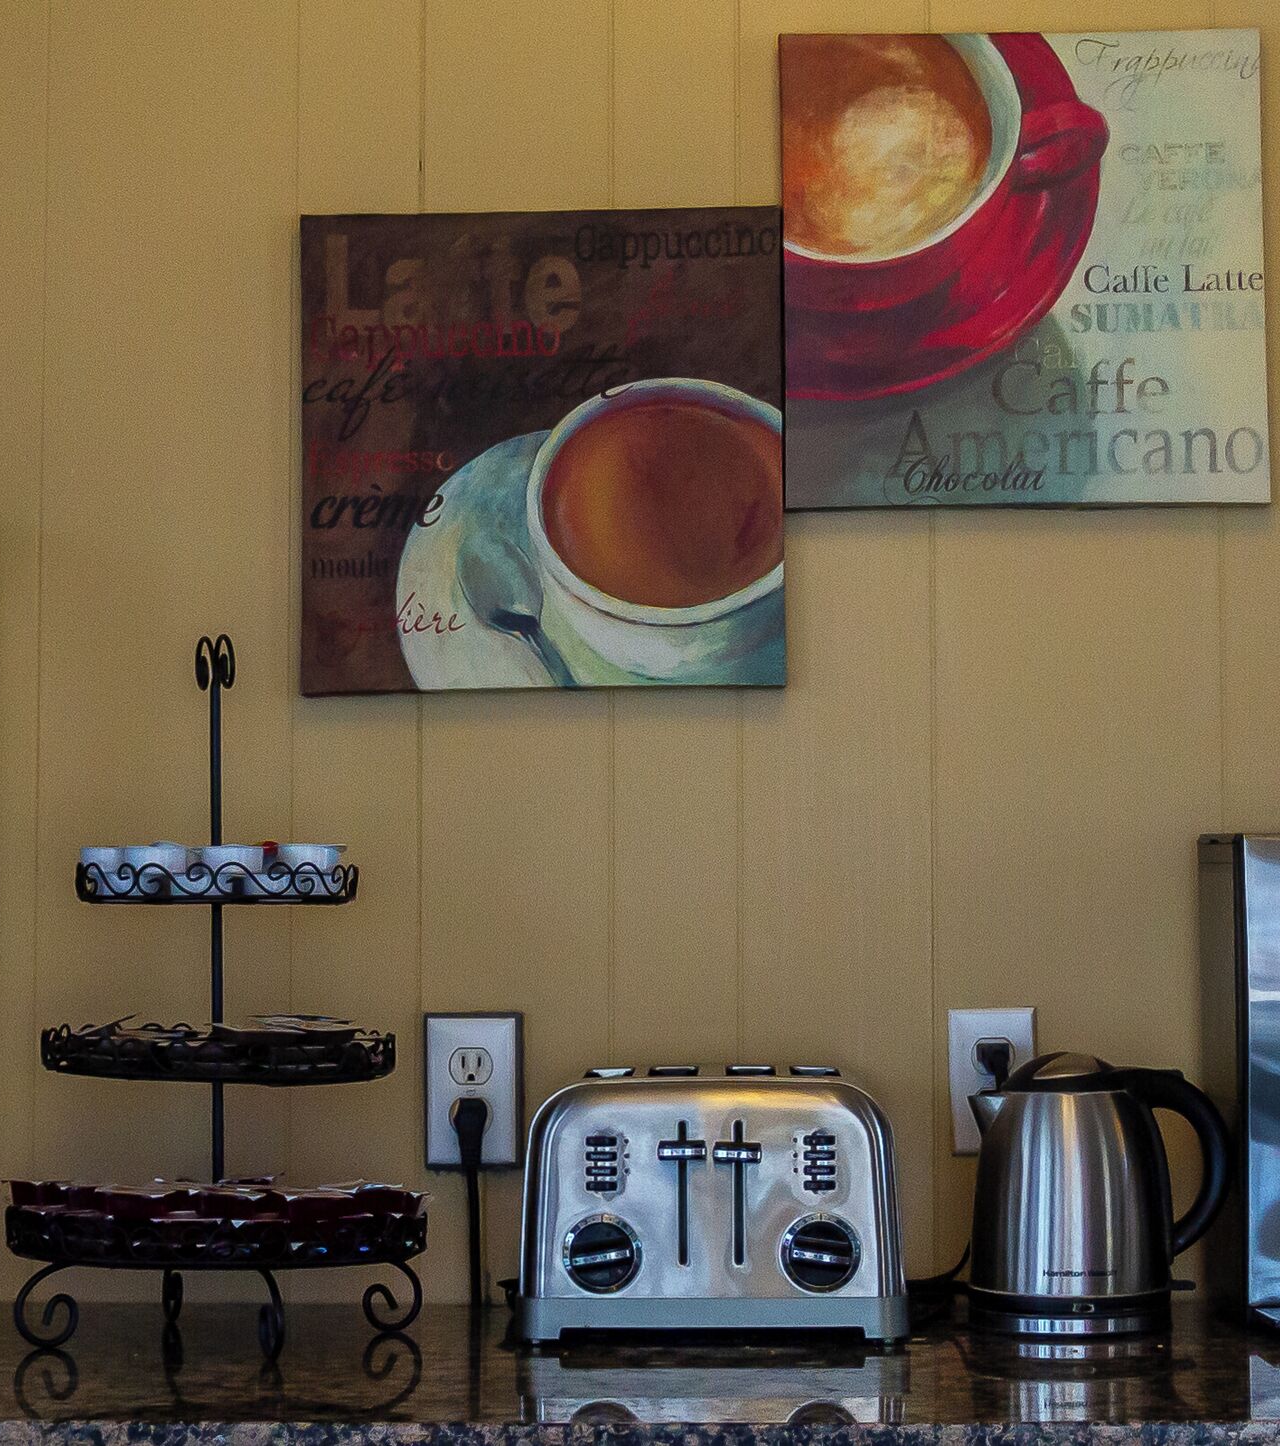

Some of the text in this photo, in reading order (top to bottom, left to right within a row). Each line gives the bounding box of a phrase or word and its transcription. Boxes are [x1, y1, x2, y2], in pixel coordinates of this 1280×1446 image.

[573, 223, 778, 269] Cappuccino
[1084, 264, 1264, 294] Caffe Latte
[310, 319, 562, 370] Cappuccino
[303, 346, 409, 439] café
[991, 358, 1170, 417] Caffe
[891, 410, 1264, 480] Americano
[892, 453, 1048, 498] Chocolat
[310, 483, 446, 530] crème
[1043, 1269, 1086, 1277] Hamilton
